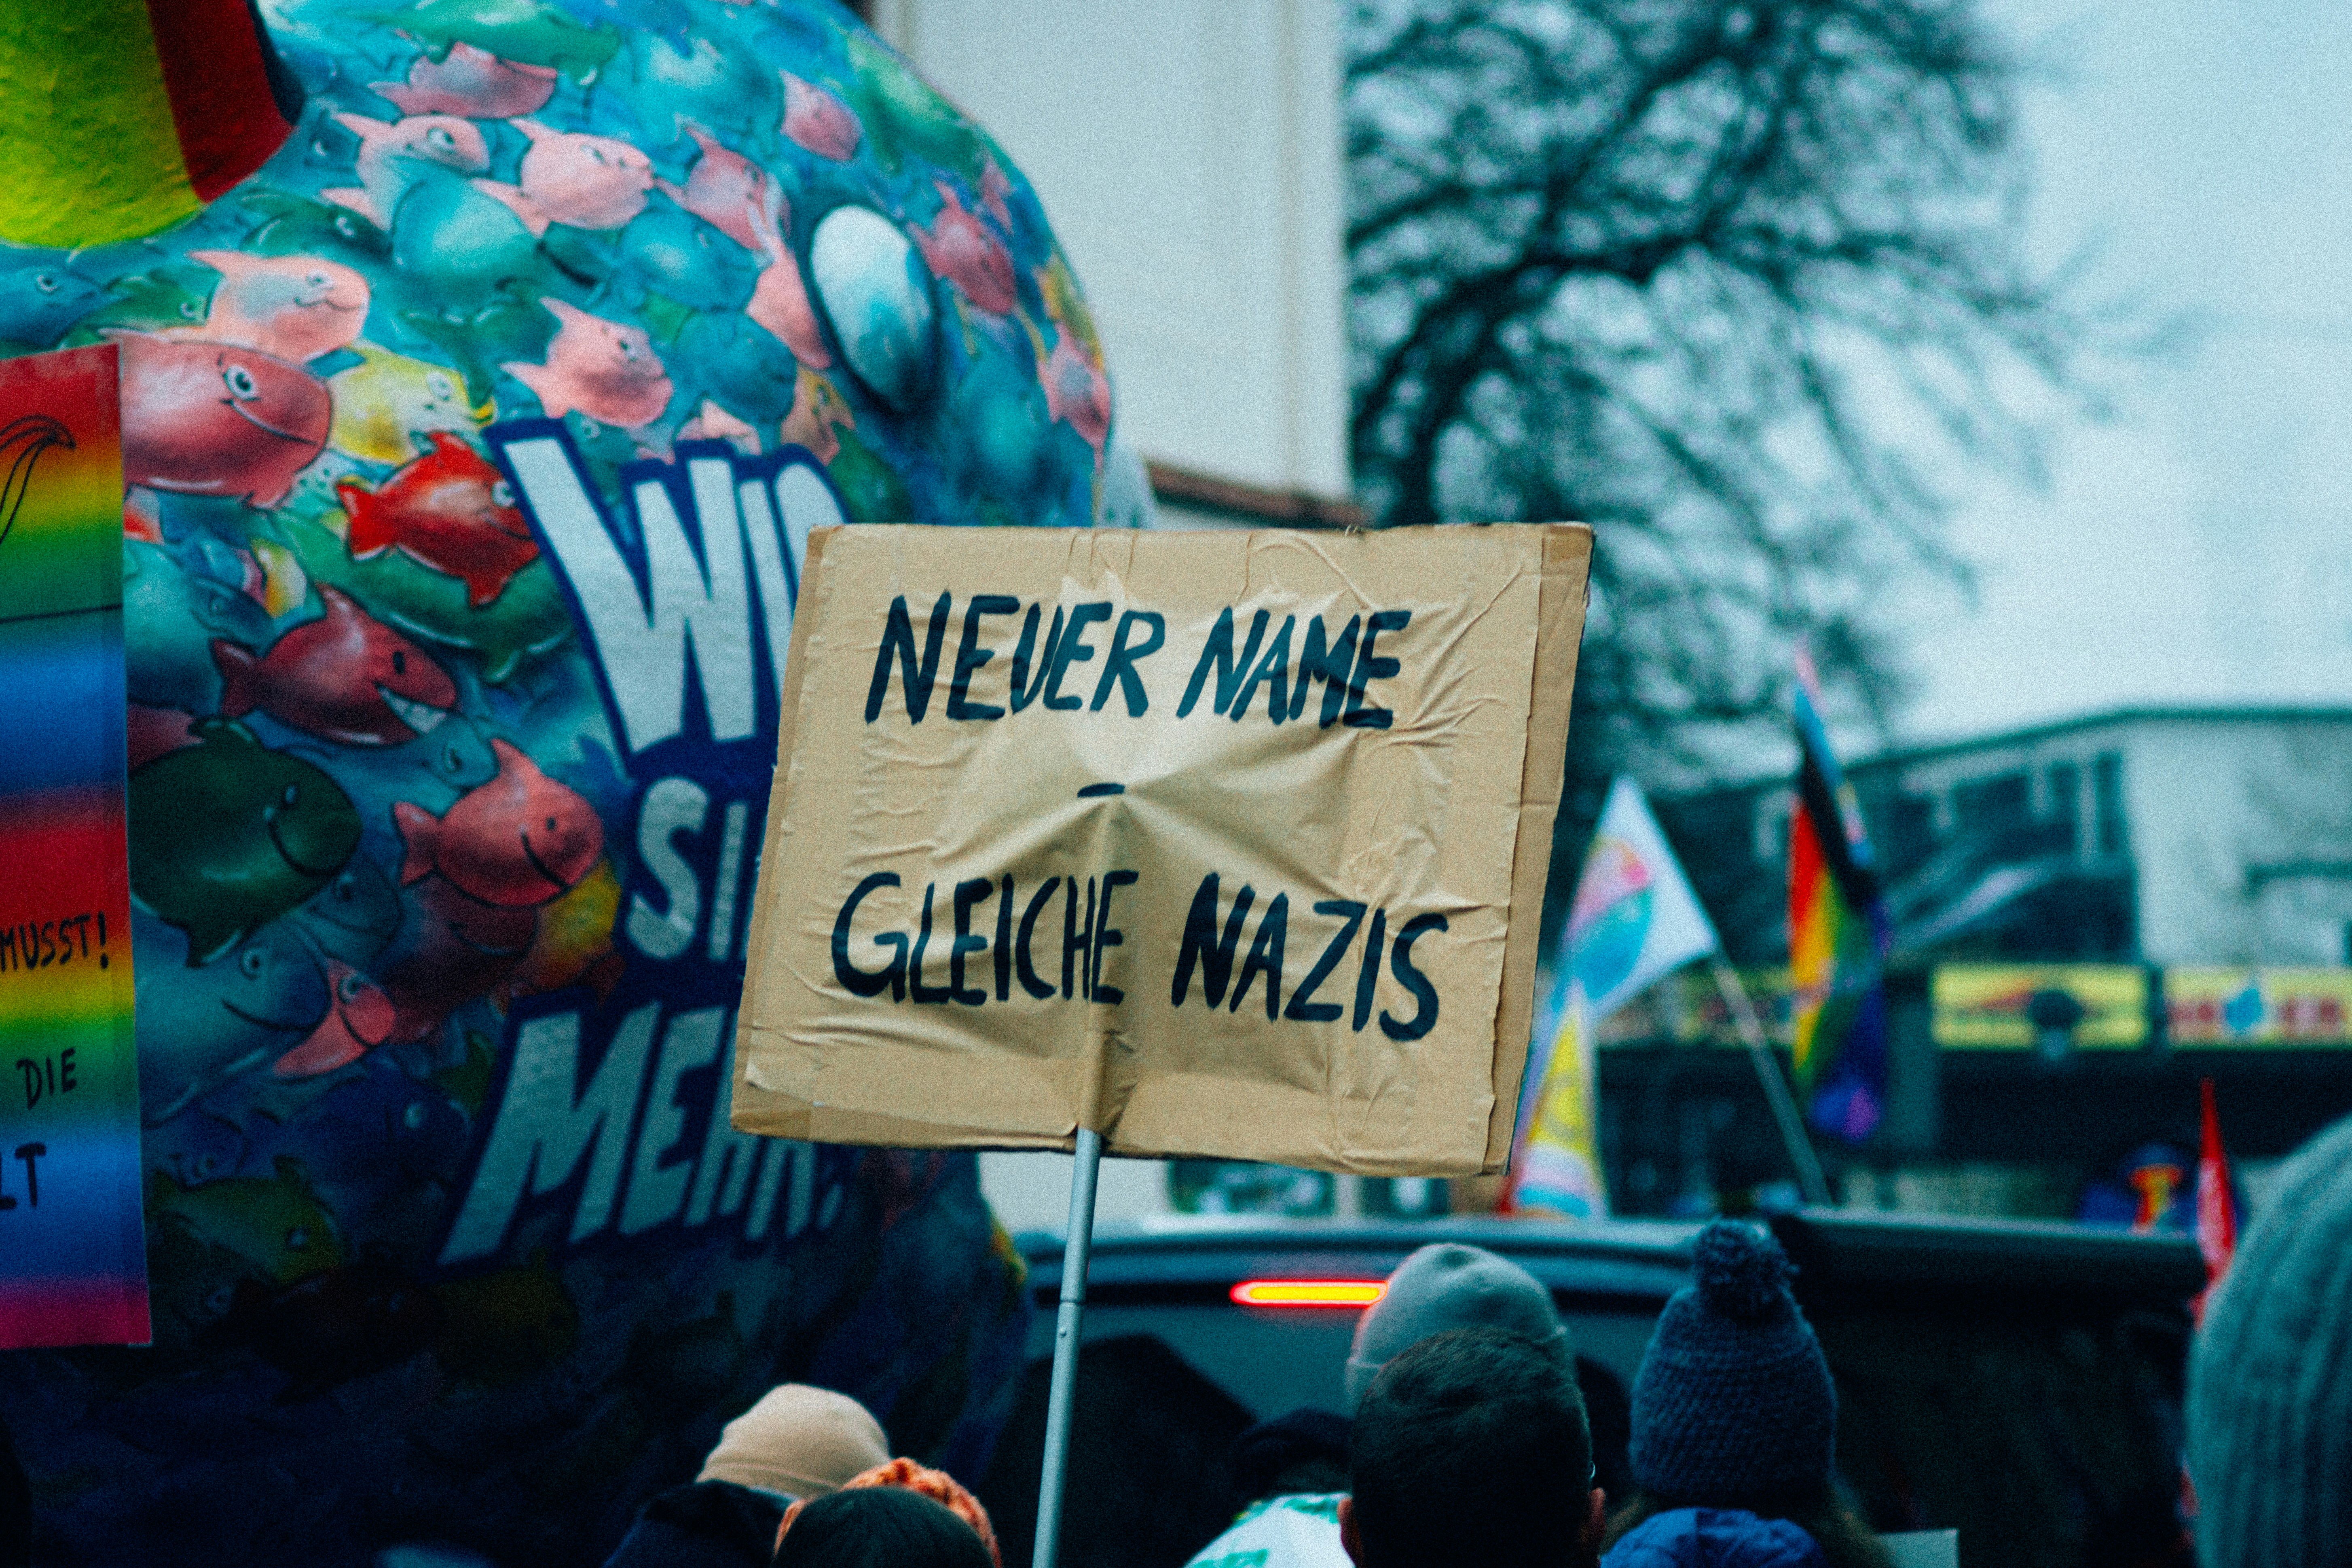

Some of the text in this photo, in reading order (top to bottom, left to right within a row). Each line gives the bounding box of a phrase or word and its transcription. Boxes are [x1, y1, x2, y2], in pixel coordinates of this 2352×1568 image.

[864, 590, 1411, 730] NEUER NAME
[0, 911, 109, 971] MUSST!
[831, 870, 1449, 1042] GLEICHE NAZIS
[16, 1047, 77, 1110] DIE
